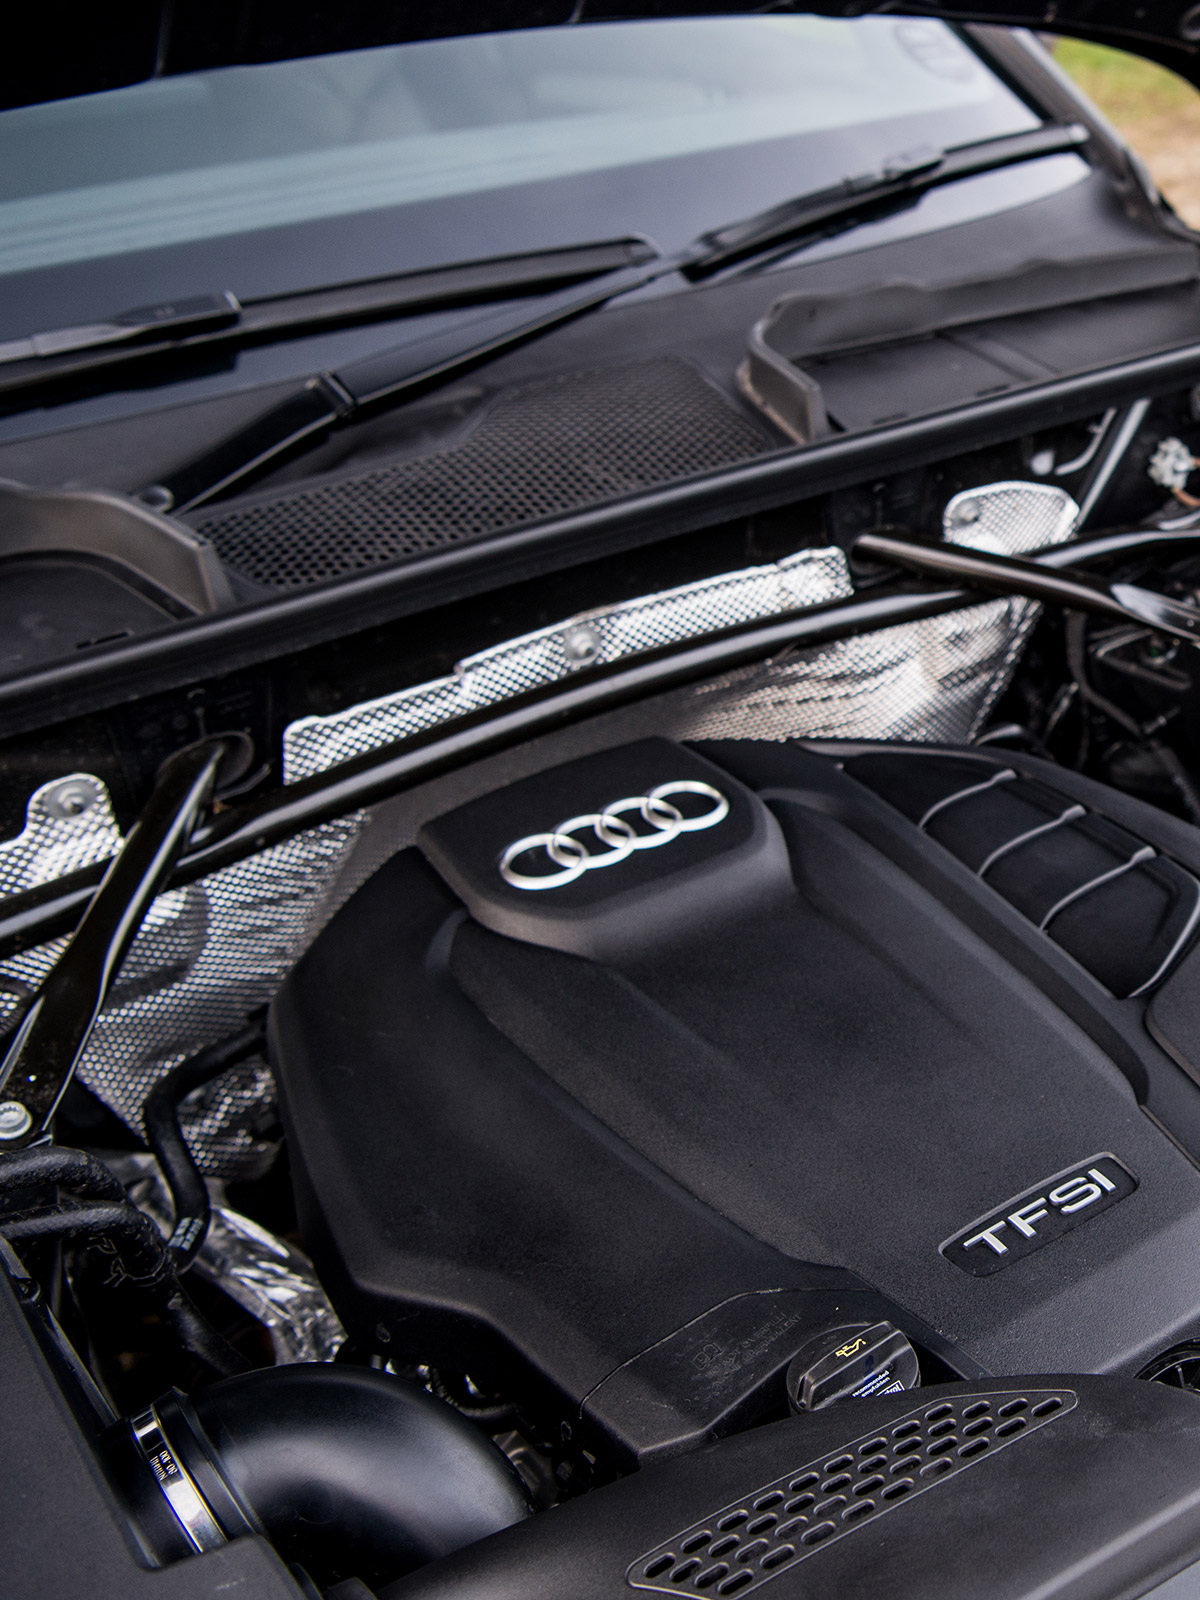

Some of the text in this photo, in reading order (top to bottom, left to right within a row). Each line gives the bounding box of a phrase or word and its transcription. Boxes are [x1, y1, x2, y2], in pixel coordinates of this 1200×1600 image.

[962, 1168, 1117, 1255] TFSI
[851, 1370, 890, 1398] recommended
[861, 1377, 891, 1398] empfohlen
[884, 1383, 902, 1395] trol
